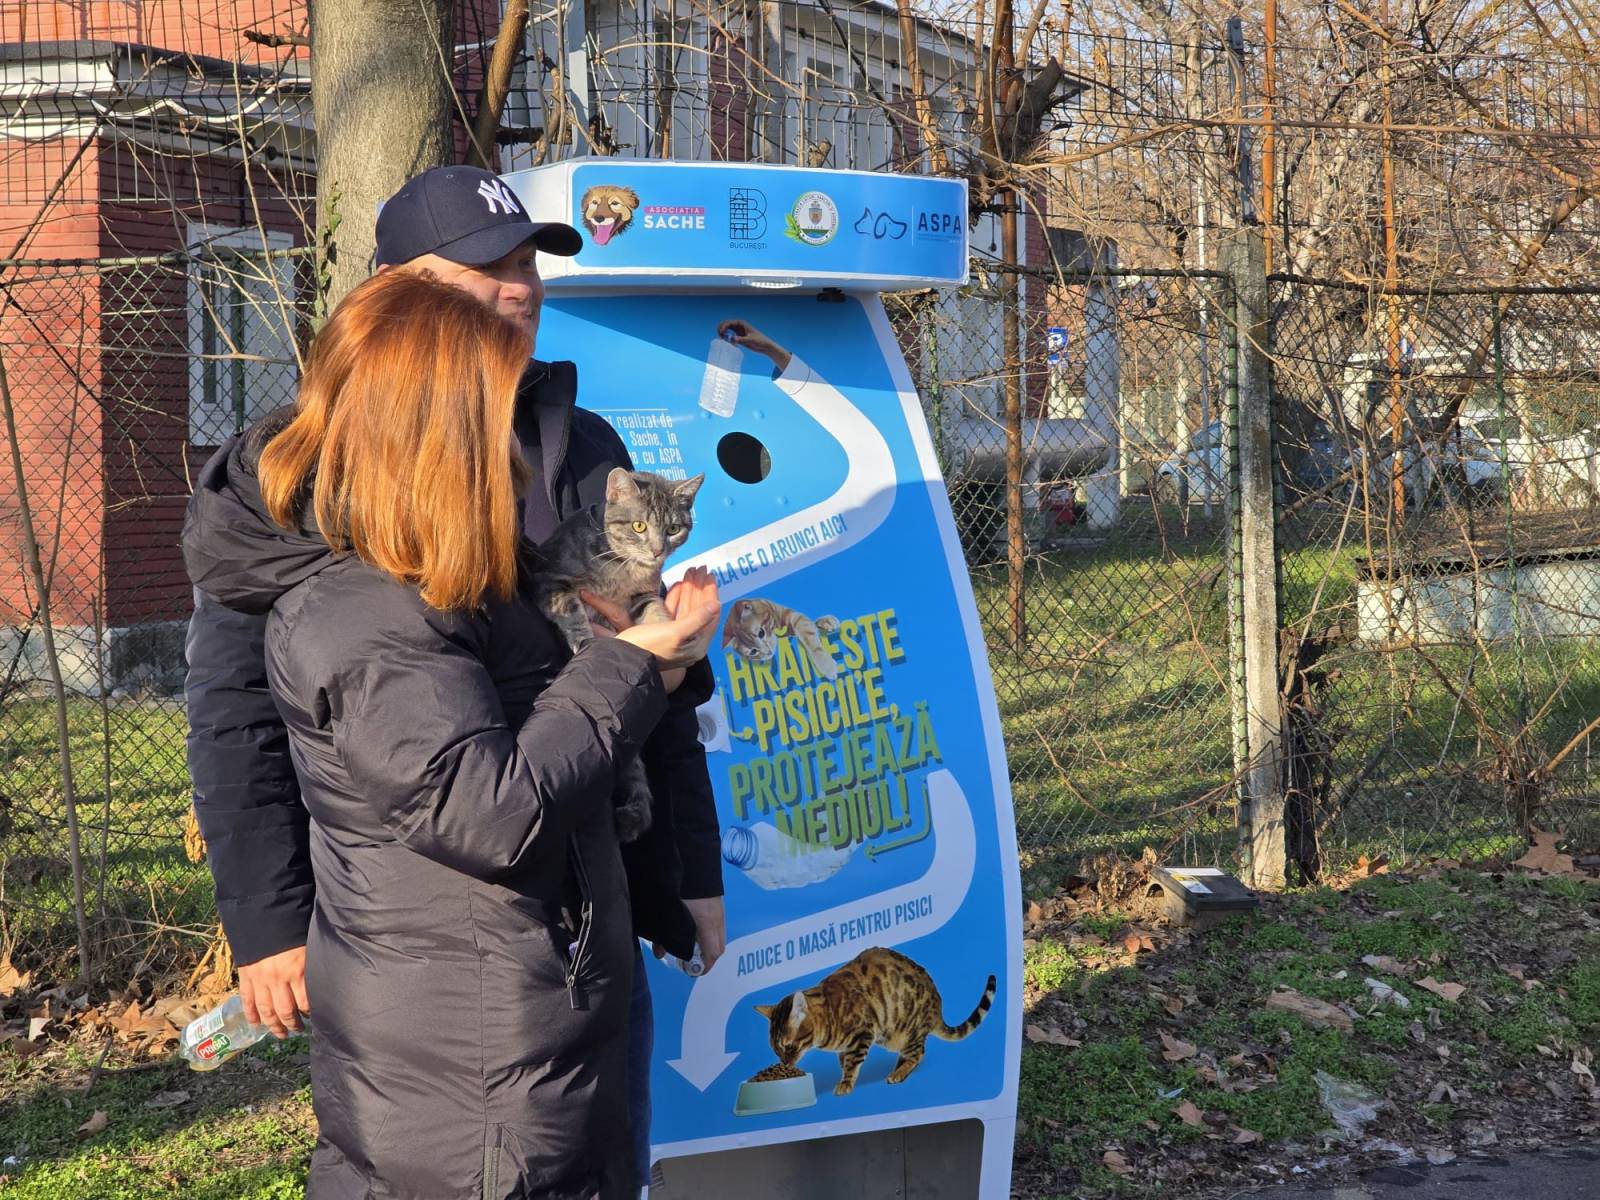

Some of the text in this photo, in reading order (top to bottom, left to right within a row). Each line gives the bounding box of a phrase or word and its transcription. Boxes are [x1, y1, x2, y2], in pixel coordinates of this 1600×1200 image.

[643, 215, 705, 229] SACHE
[918, 212, 962, 234] ASPA
[617, 413, 659, 429] realizat
[642, 451, 656, 464] cu
[658, 447, 684, 464] ASPA
[737, 552, 758, 577] CE
[756, 547, 770, 568] O
[769, 525, 821, 562] ARUNCI
[818, 512, 848, 541] AICI
[729, 699, 942, 818] PROTEJEAZĂ
[737, 894, 934, 977] ADUCE O MASĂ PENTRU PISICI
